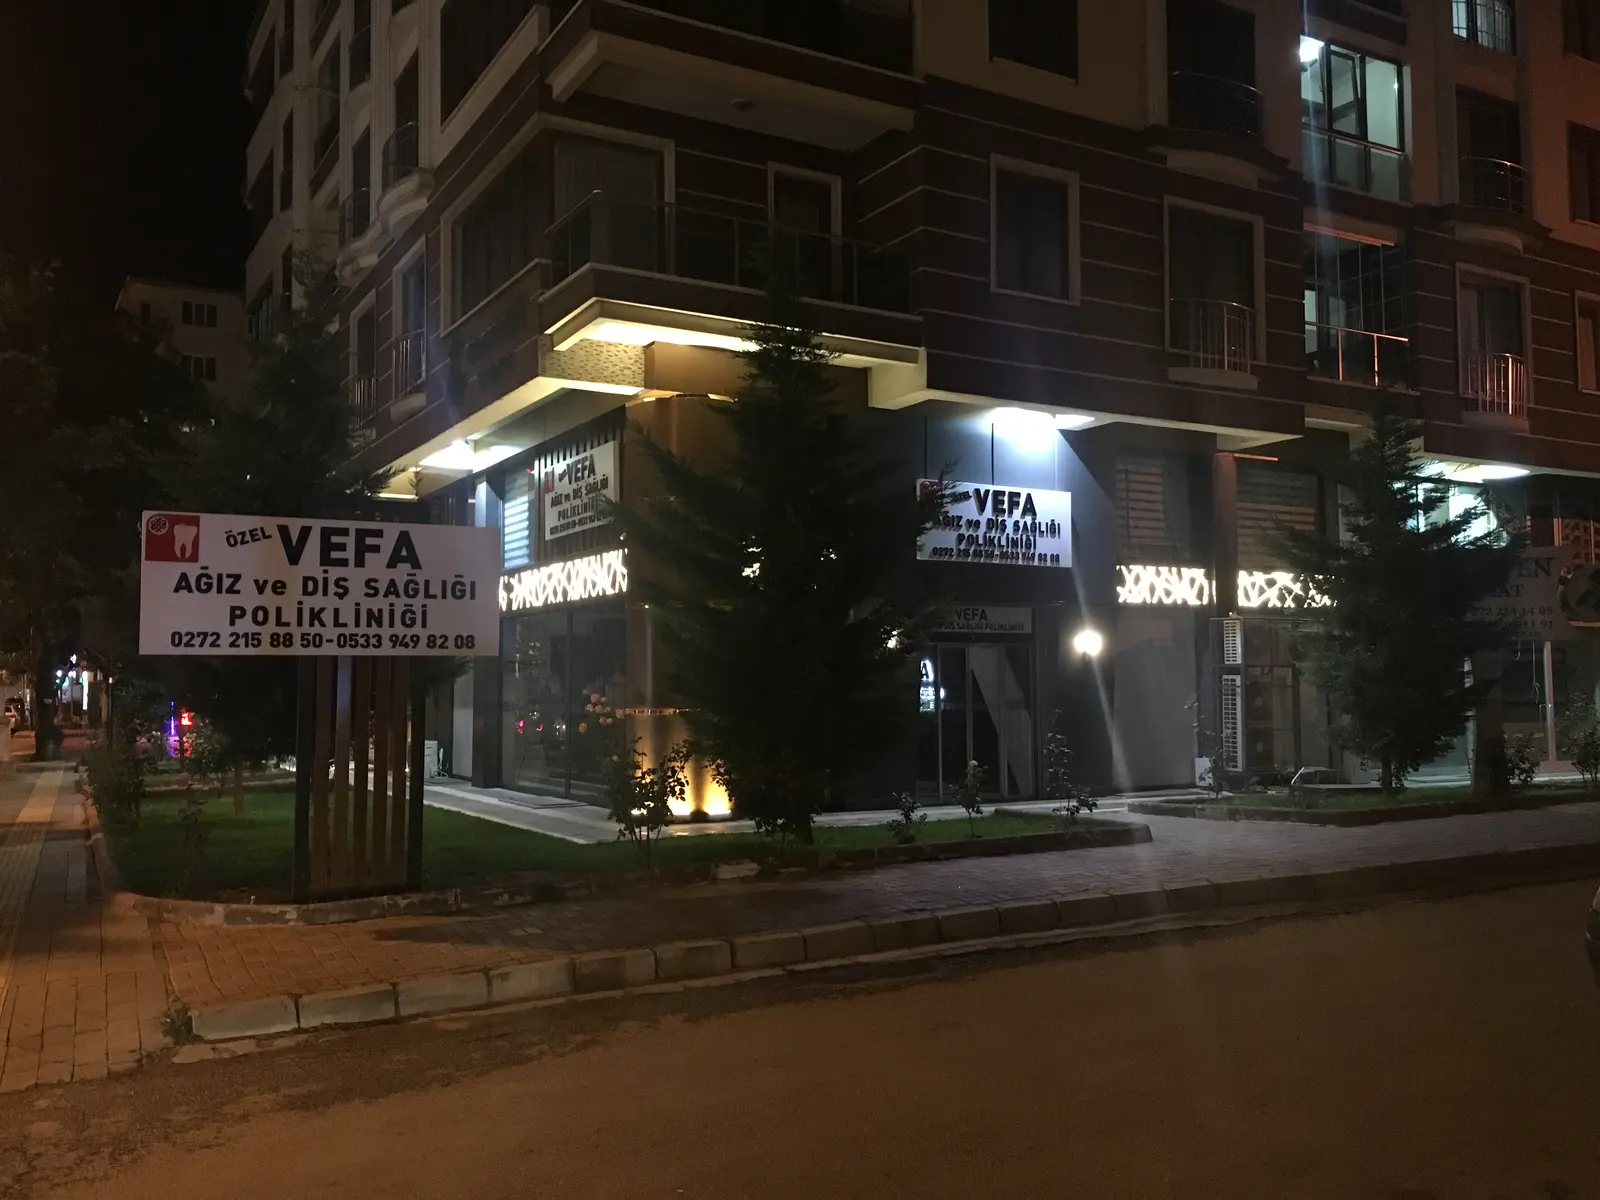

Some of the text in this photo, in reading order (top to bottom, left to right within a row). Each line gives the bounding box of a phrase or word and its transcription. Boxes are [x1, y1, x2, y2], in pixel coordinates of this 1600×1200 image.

[567, 454, 596, 485] VEFA
[973, 488, 1036, 518] VEFA
[956, 532, 1037, 550] POLİKLİNİĞİ
[966, 518, 981, 531] ve
[1013, 517, 1061, 538] SAĞLIĞI
[224, 524, 422, 569] ÖZEL VEFA
[173, 566, 476, 600] AĞIZ ve DİŞ SAĞLIĞI
[229, 601, 427, 629] POLİKLİNİĞİ
[955, 607, 988, 621] VEFA
[170, 631, 221, 648] 0272
[228, 632, 262, 648] 215
[269, 632, 293, 648] 88
[388, 634, 420, 649] 949
[426, 635, 448, 649] 82
[454, 635, 475, 649] 08
